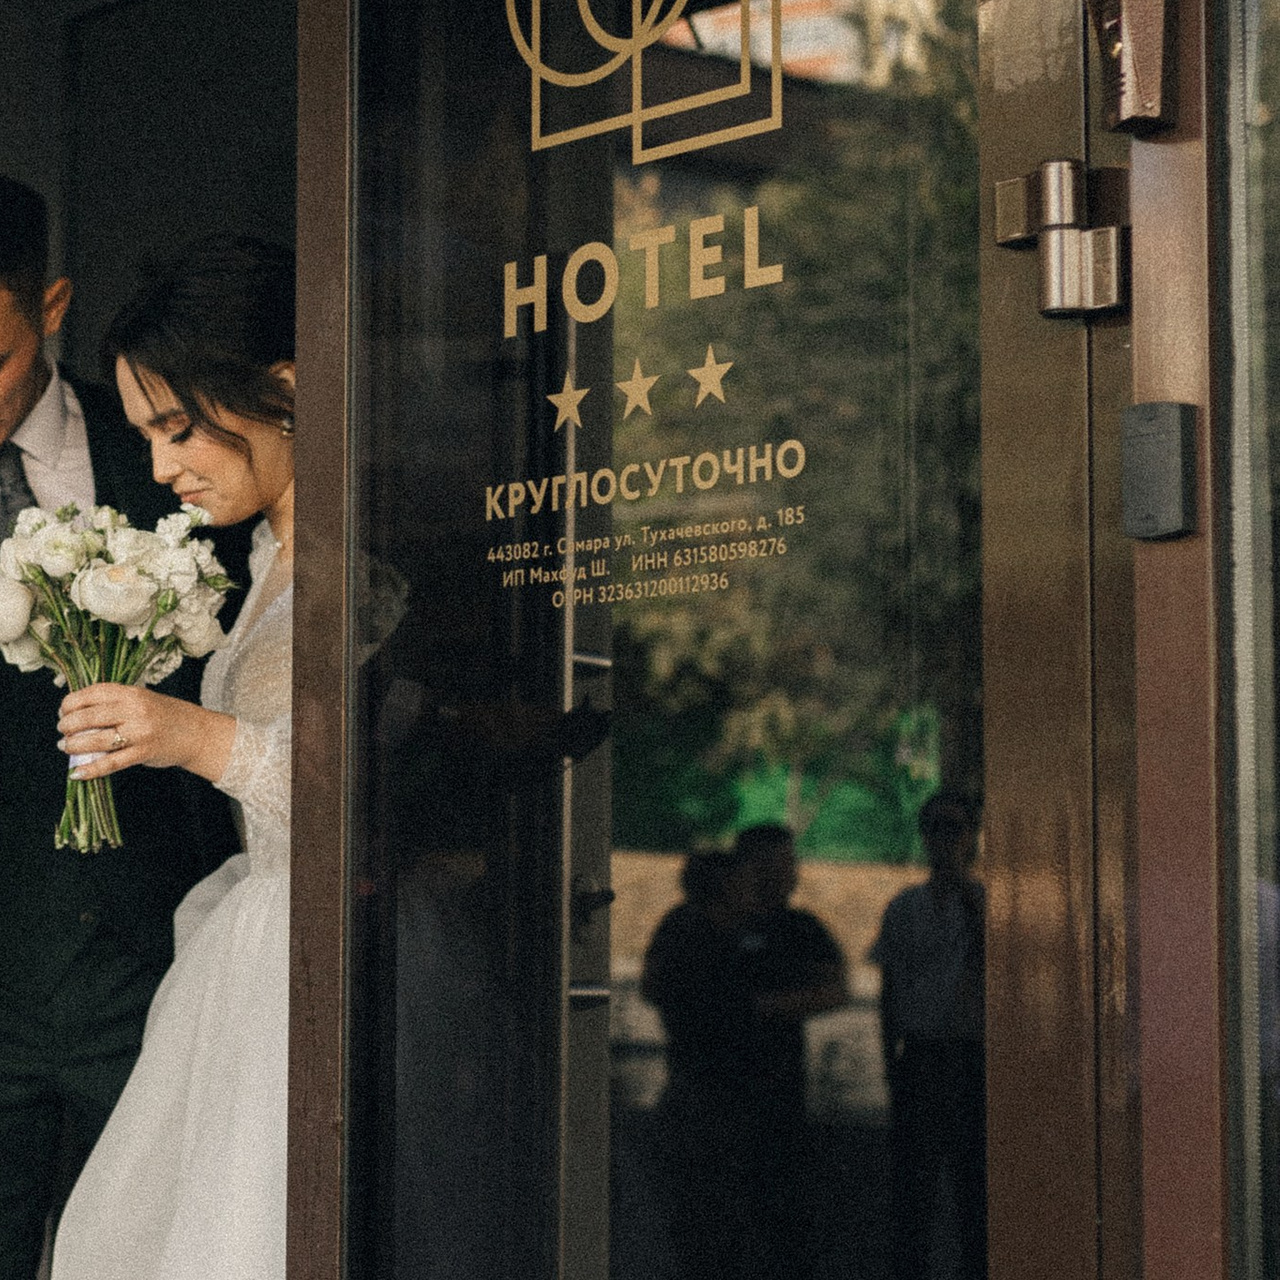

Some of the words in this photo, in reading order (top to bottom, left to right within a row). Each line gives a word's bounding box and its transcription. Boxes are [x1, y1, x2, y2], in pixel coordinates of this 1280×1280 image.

[504, 205, 783, 338] HOTEL
[485, 439, 806, 521] КРУГЛОСУТОЧНО
[487, 541, 539, 563] 443082
[543, 544, 553, 557] г.
[615, 533, 635, 551] ул.
[641, 518, 752, 547] Тухачевского,
[756, 516, 772, 532] д.
[777, 505, 805, 526] 185
[502, 568, 524, 588] ИП
[591, 558, 610, 577] Ш.
[632, 551, 668, 572] ИНН
[673, 537, 787, 567] 631580598276
[552, 587, 593, 608] ОРН
[598, 572, 729, 603] 323631200112936
